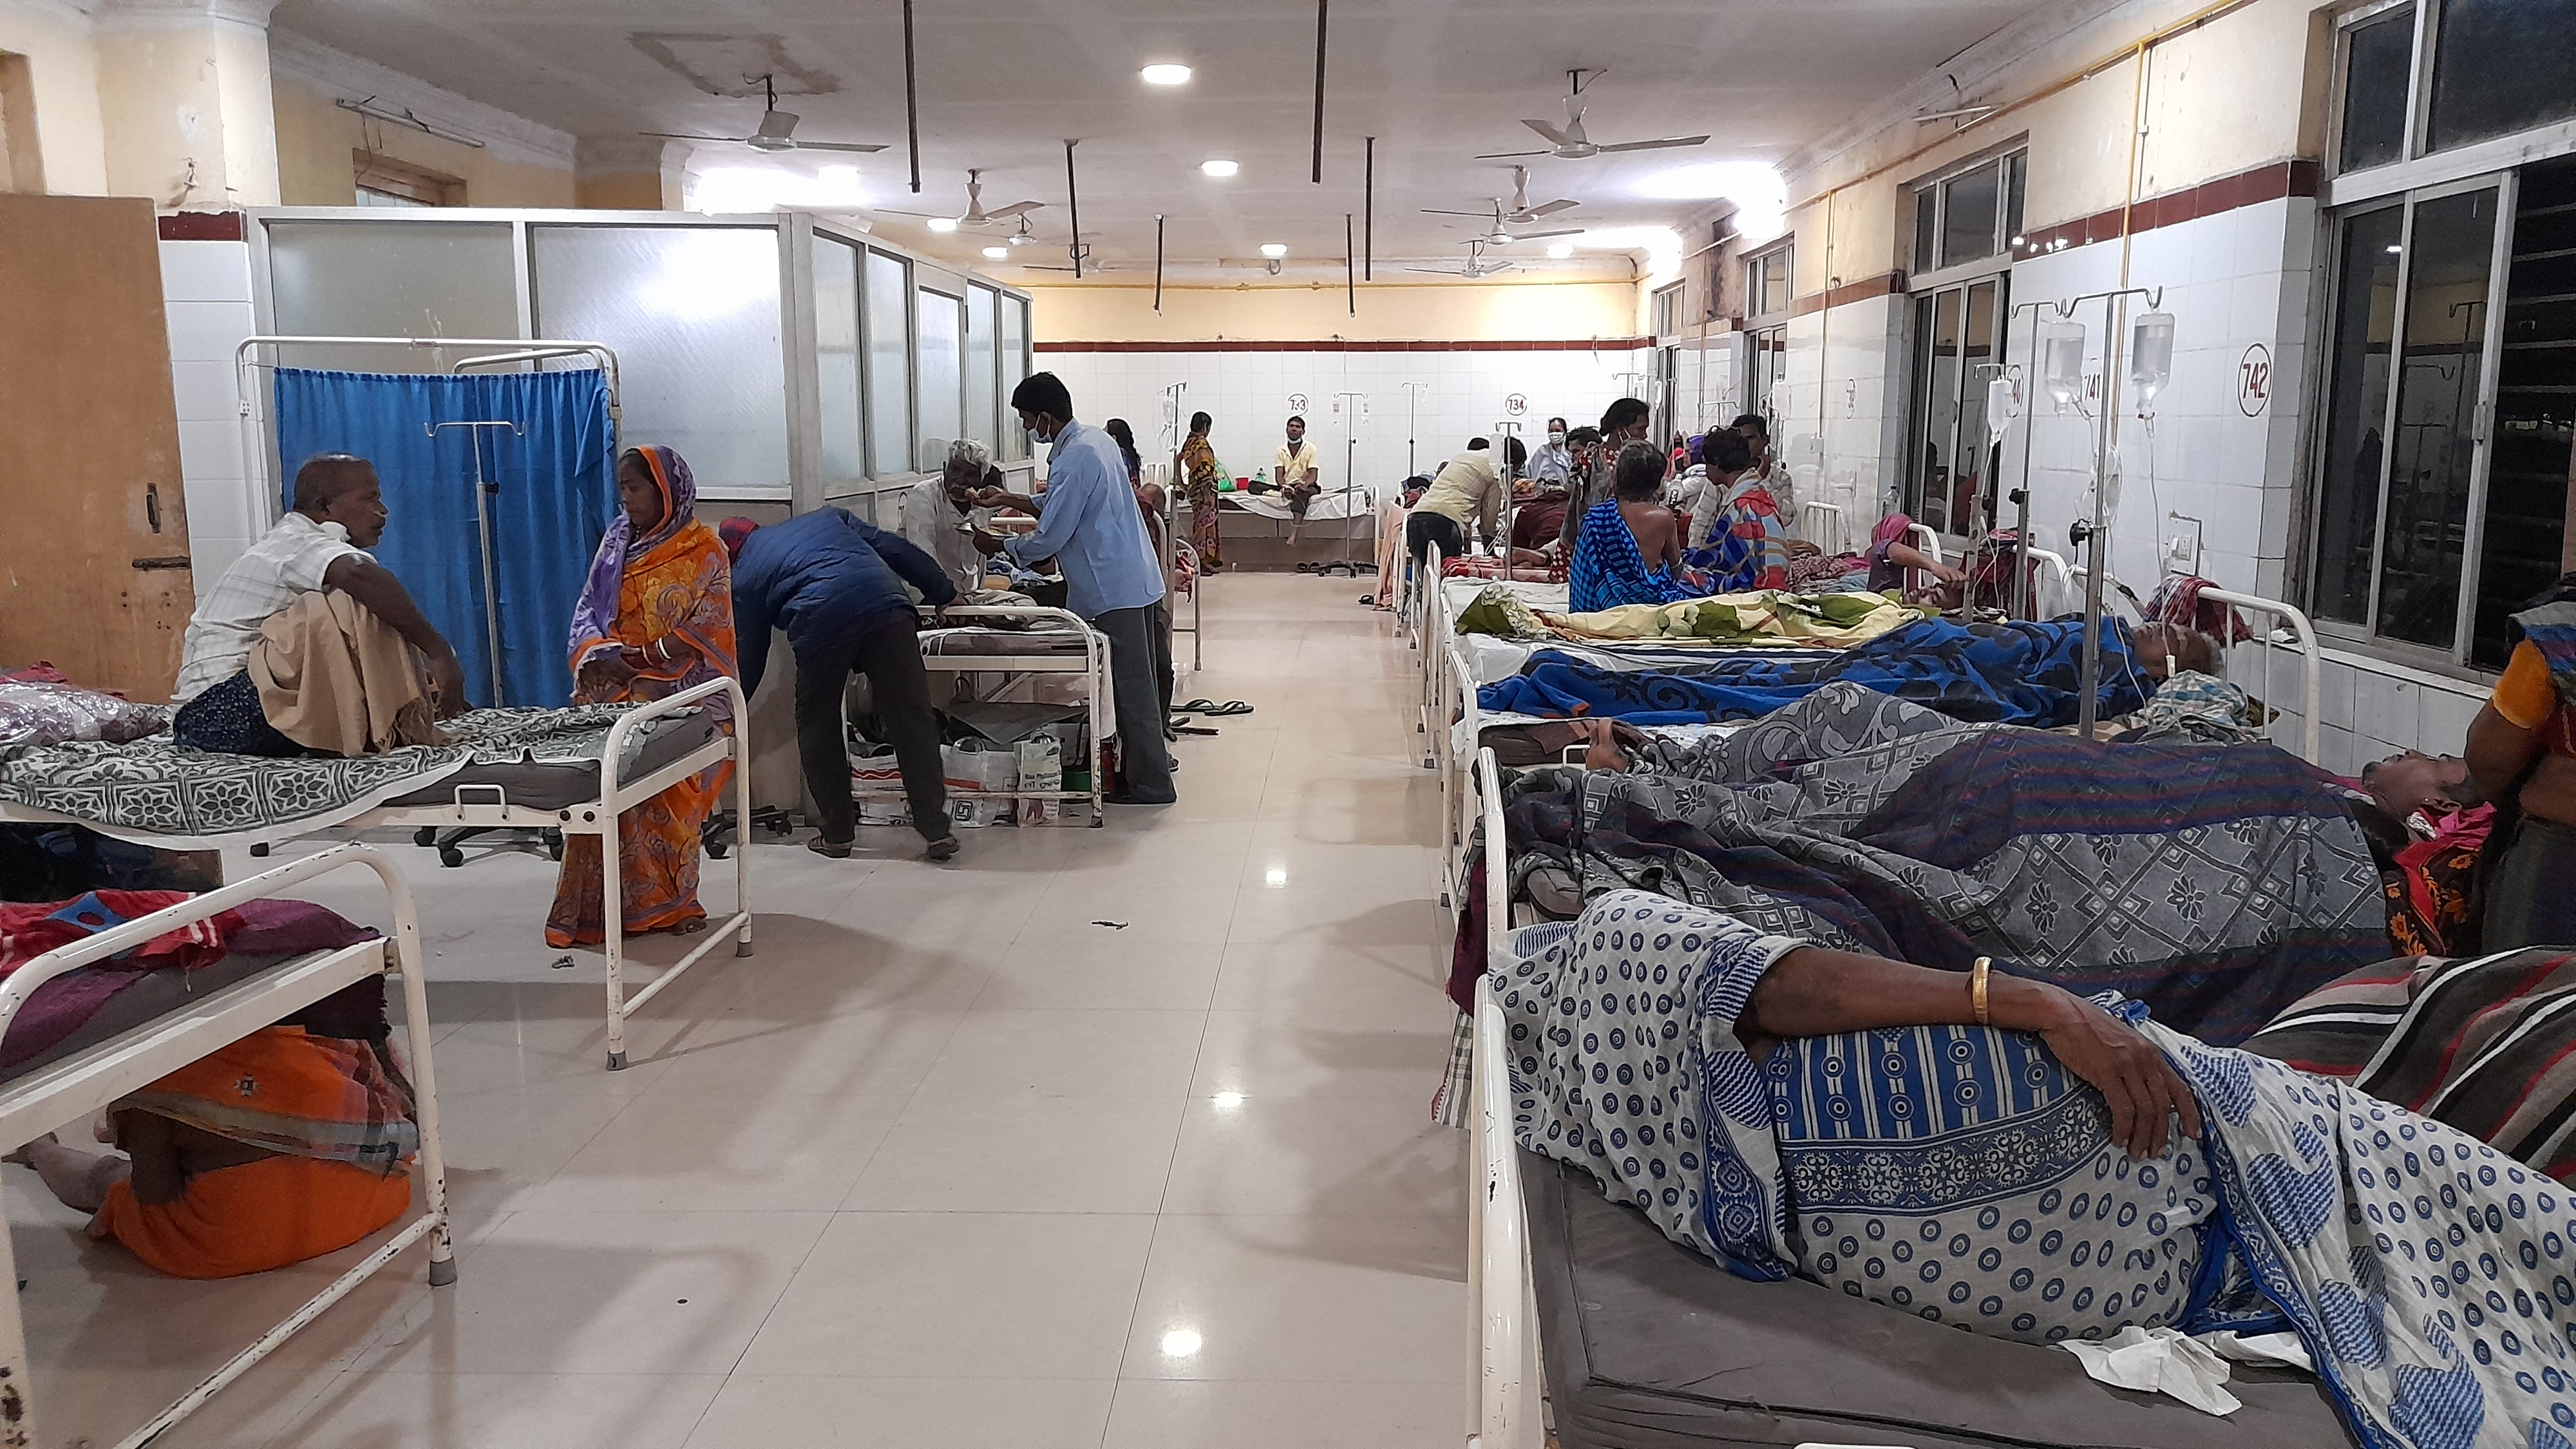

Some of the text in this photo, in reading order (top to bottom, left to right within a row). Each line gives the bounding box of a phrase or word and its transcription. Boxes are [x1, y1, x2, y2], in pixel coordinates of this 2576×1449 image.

[2007, 378, 2021, 404] 40
[2085, 374, 2100, 401] 741
[2242, 362, 2269, 399] 742
[1508, 399, 1524, 410] 734
